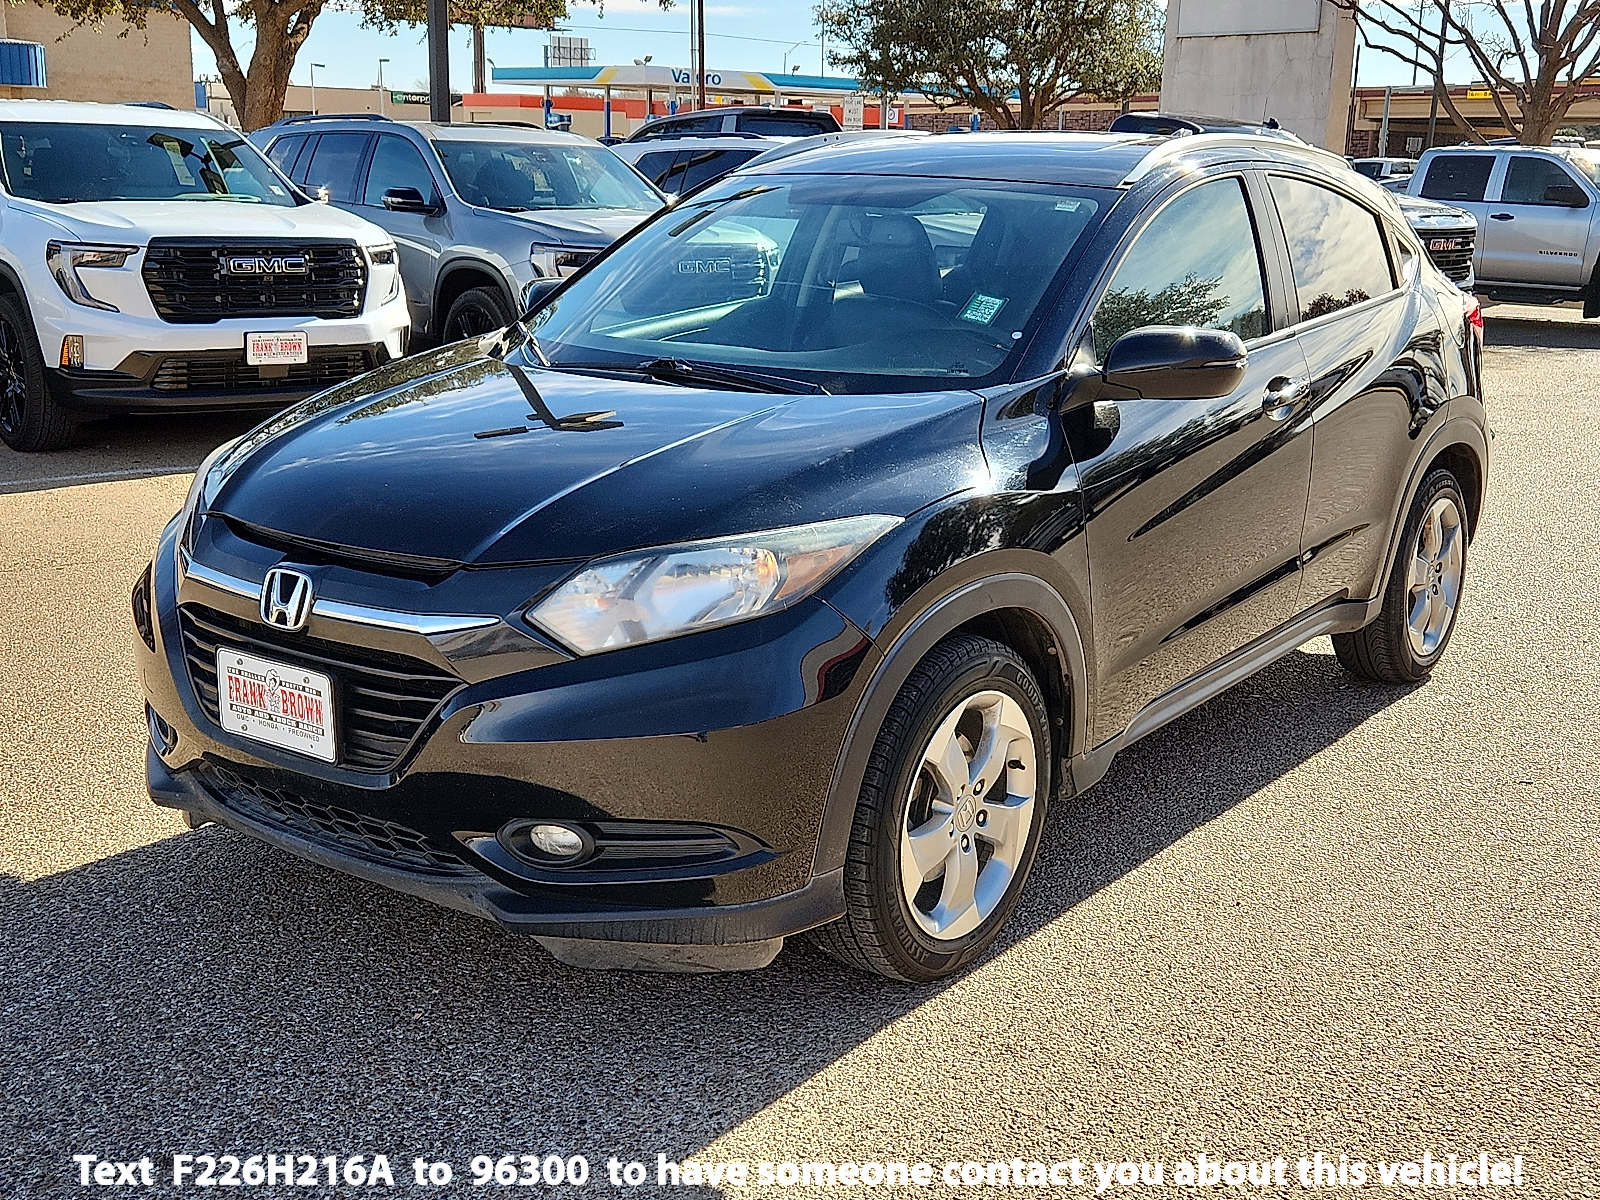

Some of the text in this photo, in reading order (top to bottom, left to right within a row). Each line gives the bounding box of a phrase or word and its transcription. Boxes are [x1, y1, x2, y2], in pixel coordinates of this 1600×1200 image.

[671, 69, 721, 85] Varo
[1430, 239, 1462, 250] GMC
[229, 257, 306, 273] GMC
[679, 259, 731, 273] GMC
[252, 341, 302, 352] FRANK BROWN
[228, 674, 324, 728] FRANK BROWN
[231, 705, 323, 736] AUTO AND TRUCK RANCH
[258, 719, 279, 731] HONDA
[288, 727, 320, 743] PREOWNED
